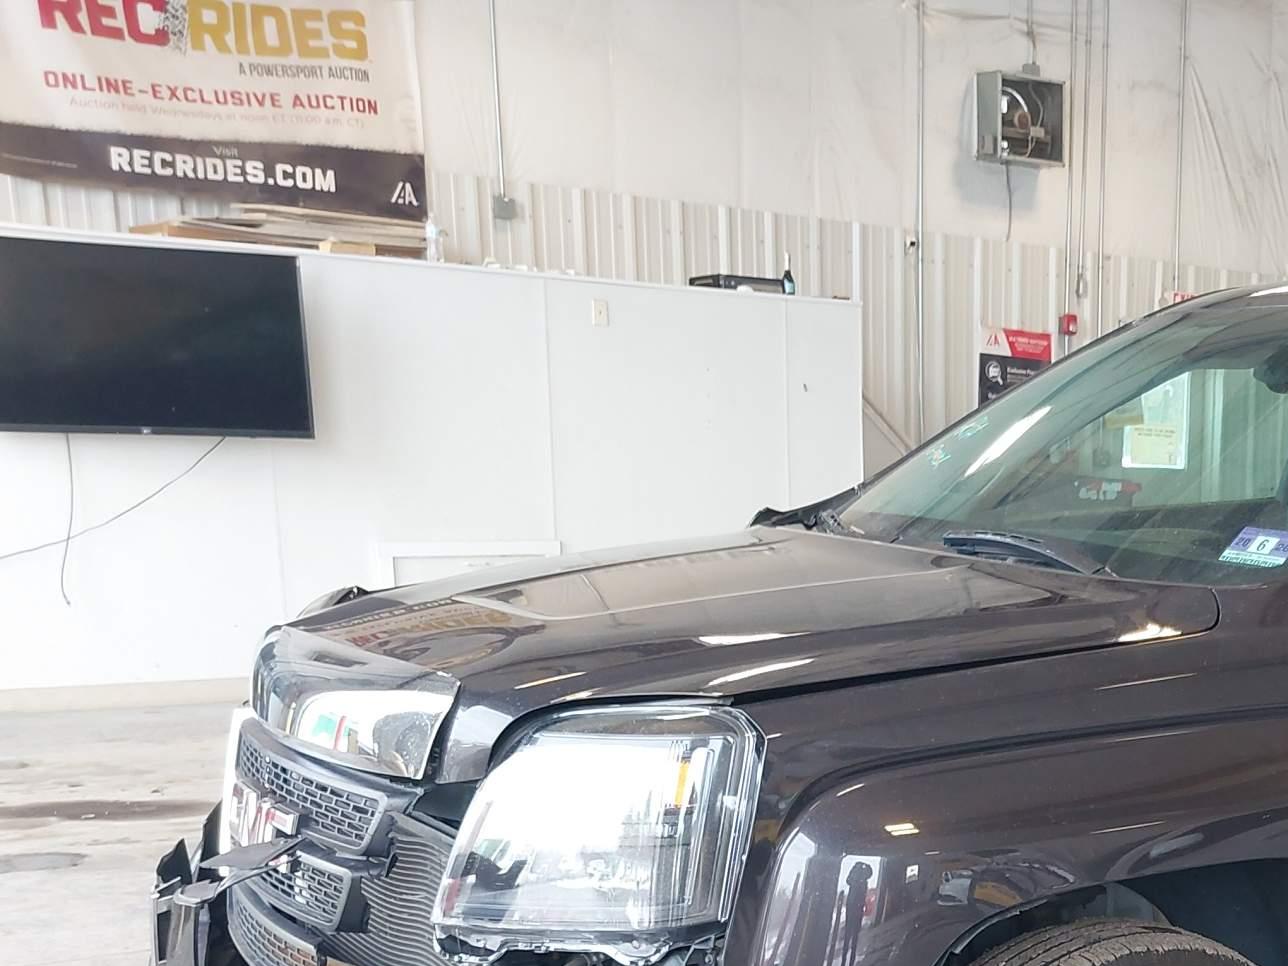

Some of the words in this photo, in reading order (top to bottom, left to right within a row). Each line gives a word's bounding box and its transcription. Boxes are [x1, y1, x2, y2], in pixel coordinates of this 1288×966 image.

[37, 0, 171, 46] REC
[187, 0, 369, 62] RIDES
[239, 62, 247, 76] A
[249, 63, 324, 79] POWERSPORT
[327, 66, 370, 83] AUCTION
[44, 70, 283, 108] ONLINE-EXCLUSIVE
[292, 94, 379, 116] AUCTION
[212, 145, 239, 157] Visit
[110, 146, 337, 193] RECRIDES.COM
[1256, 538, 1270, 552] 6
